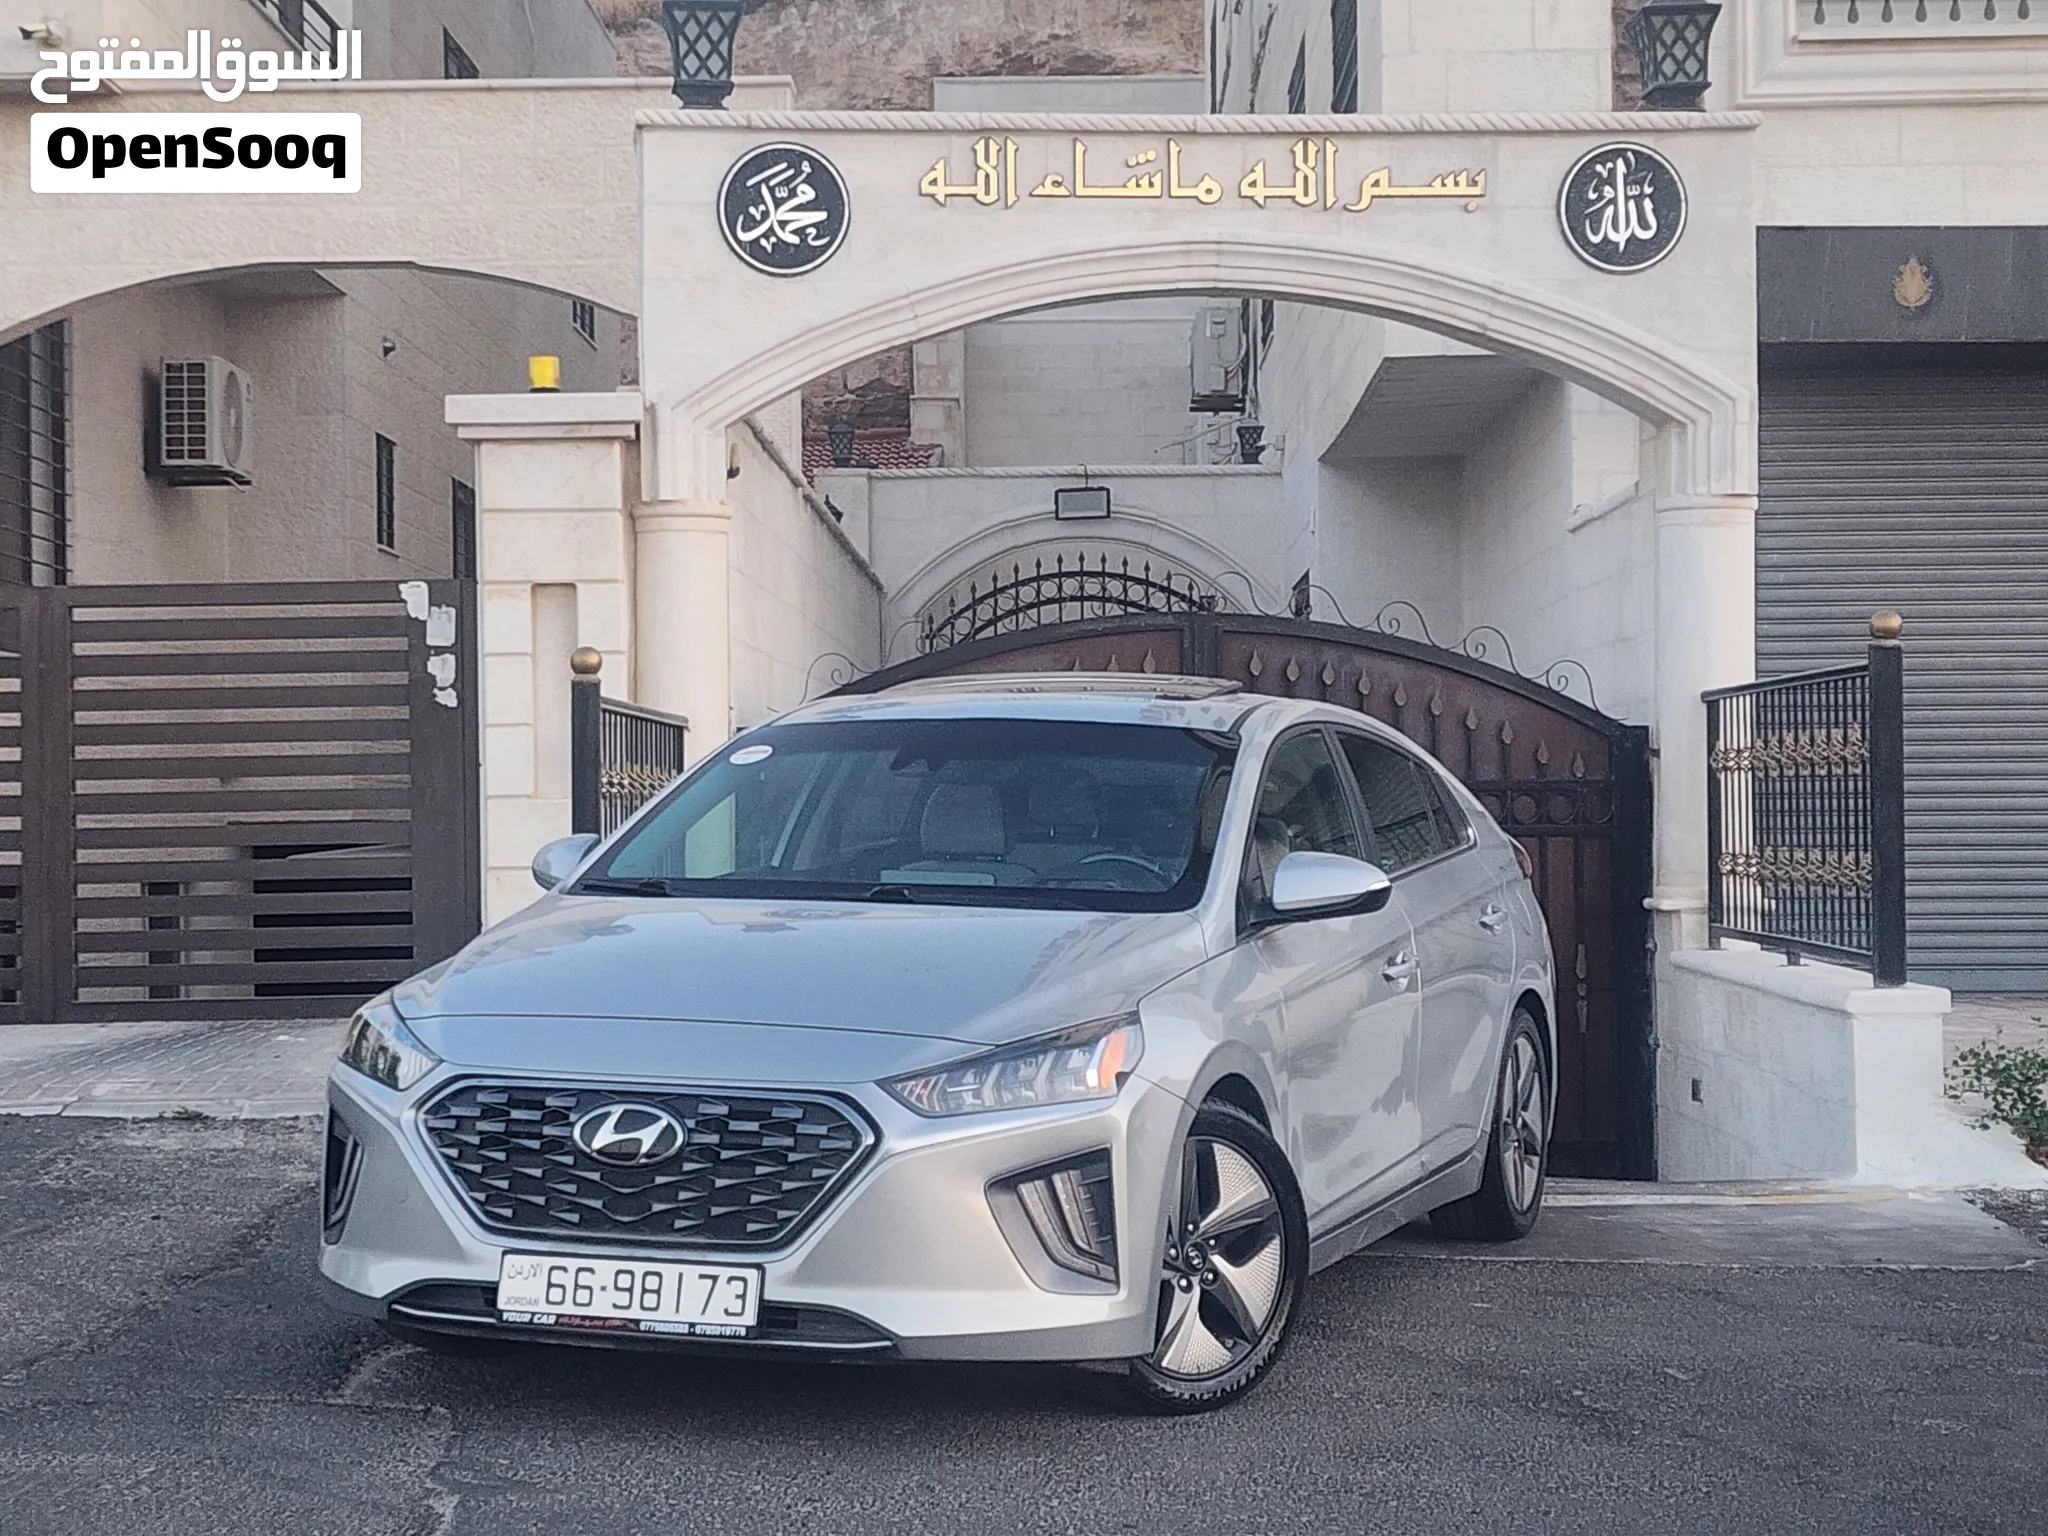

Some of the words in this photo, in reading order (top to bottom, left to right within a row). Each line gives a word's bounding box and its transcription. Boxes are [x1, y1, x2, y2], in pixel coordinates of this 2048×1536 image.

[1344, 165, 1487, 212] بسم
[504, 1296, 540, 1307] JORDAN
[502, 1312, 532, 1322] YOUR
[533, 1313, 557, 1325] CAR
